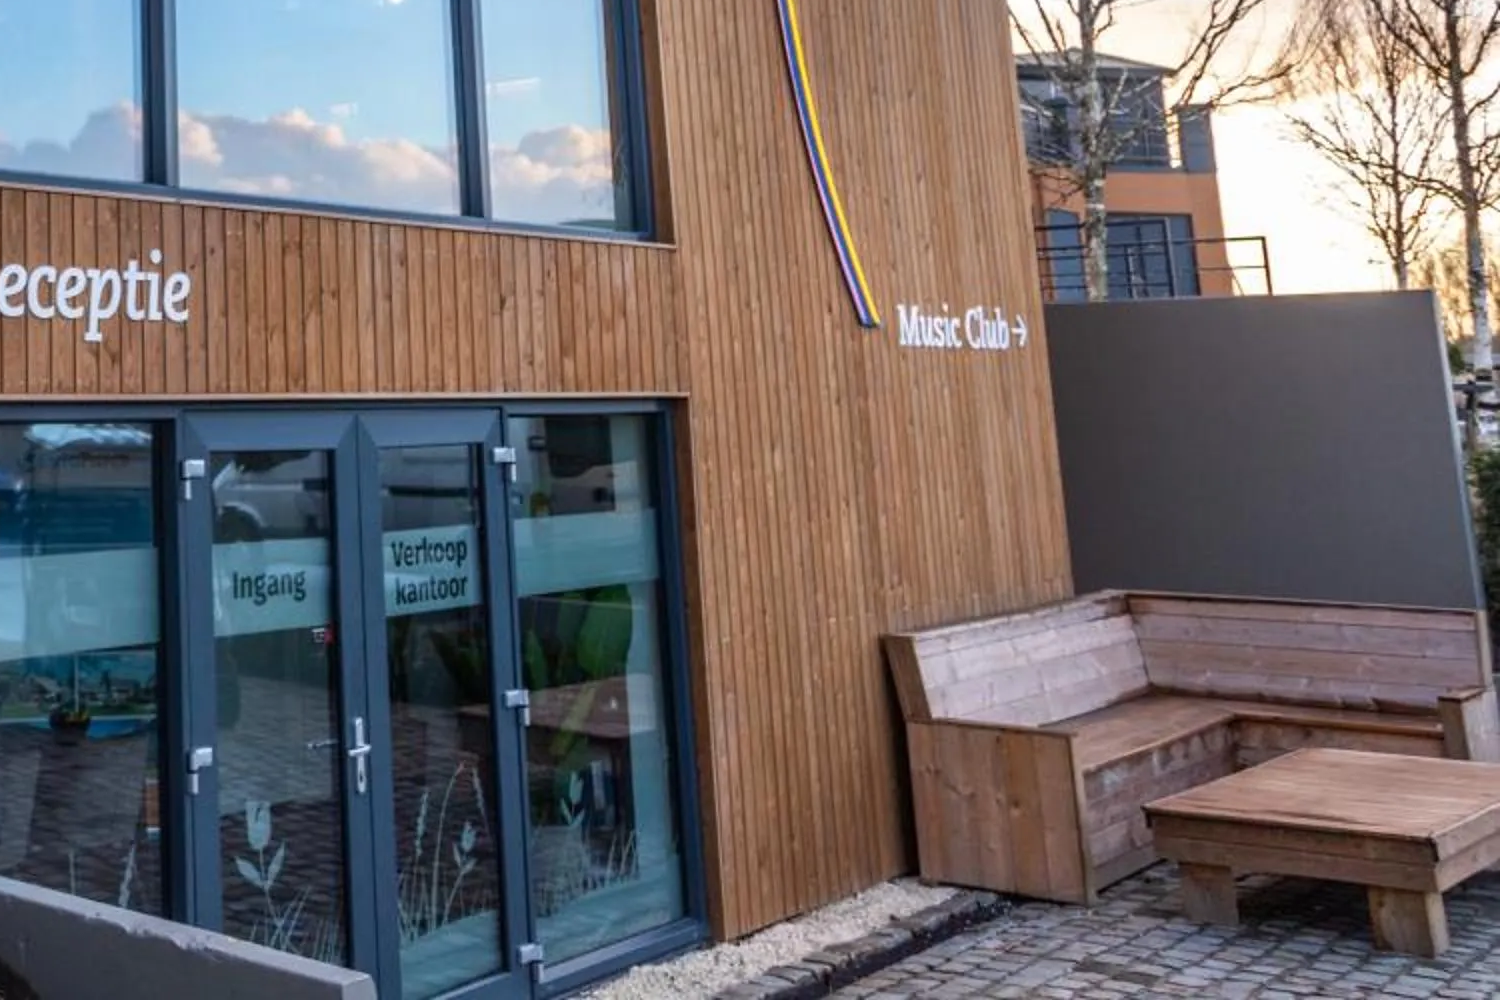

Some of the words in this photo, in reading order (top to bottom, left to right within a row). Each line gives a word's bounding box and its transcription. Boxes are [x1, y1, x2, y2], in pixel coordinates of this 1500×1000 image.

[896, 301, 963, 348] Music
[965, 304, 1010, 350] Club
[390, 536, 469, 568] Verkoop
[232, 570, 307, 606] Ingang
[394, 573, 469, 607] kantoor
